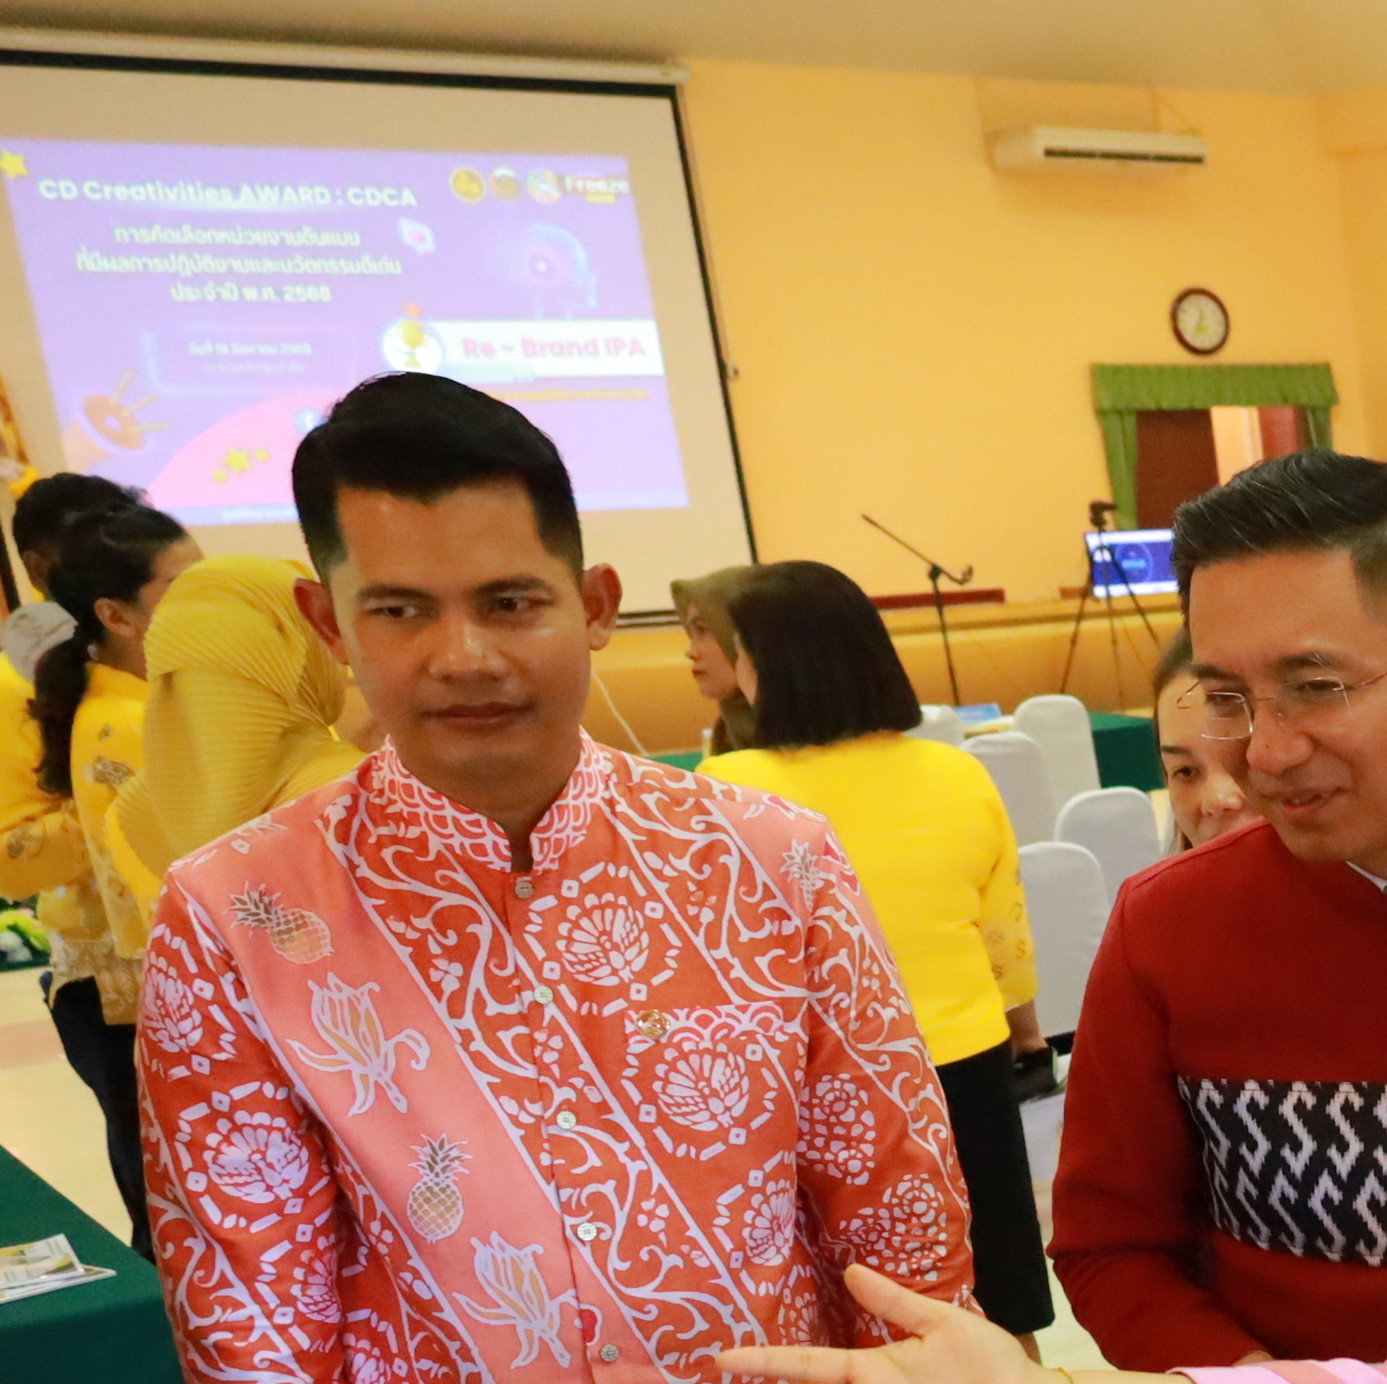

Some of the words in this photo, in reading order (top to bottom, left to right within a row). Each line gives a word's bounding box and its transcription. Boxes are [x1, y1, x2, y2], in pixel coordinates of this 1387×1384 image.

[38, 179, 79, 201] CD
[82, 180, 232, 205] Creativities
[238, 185, 331, 206] AWARD
[346, 186, 418, 207] CDCA
[462, 337, 496, 358] Re
[520, 337, 600, 359] Brand
[604, 337, 647, 358] IPA
